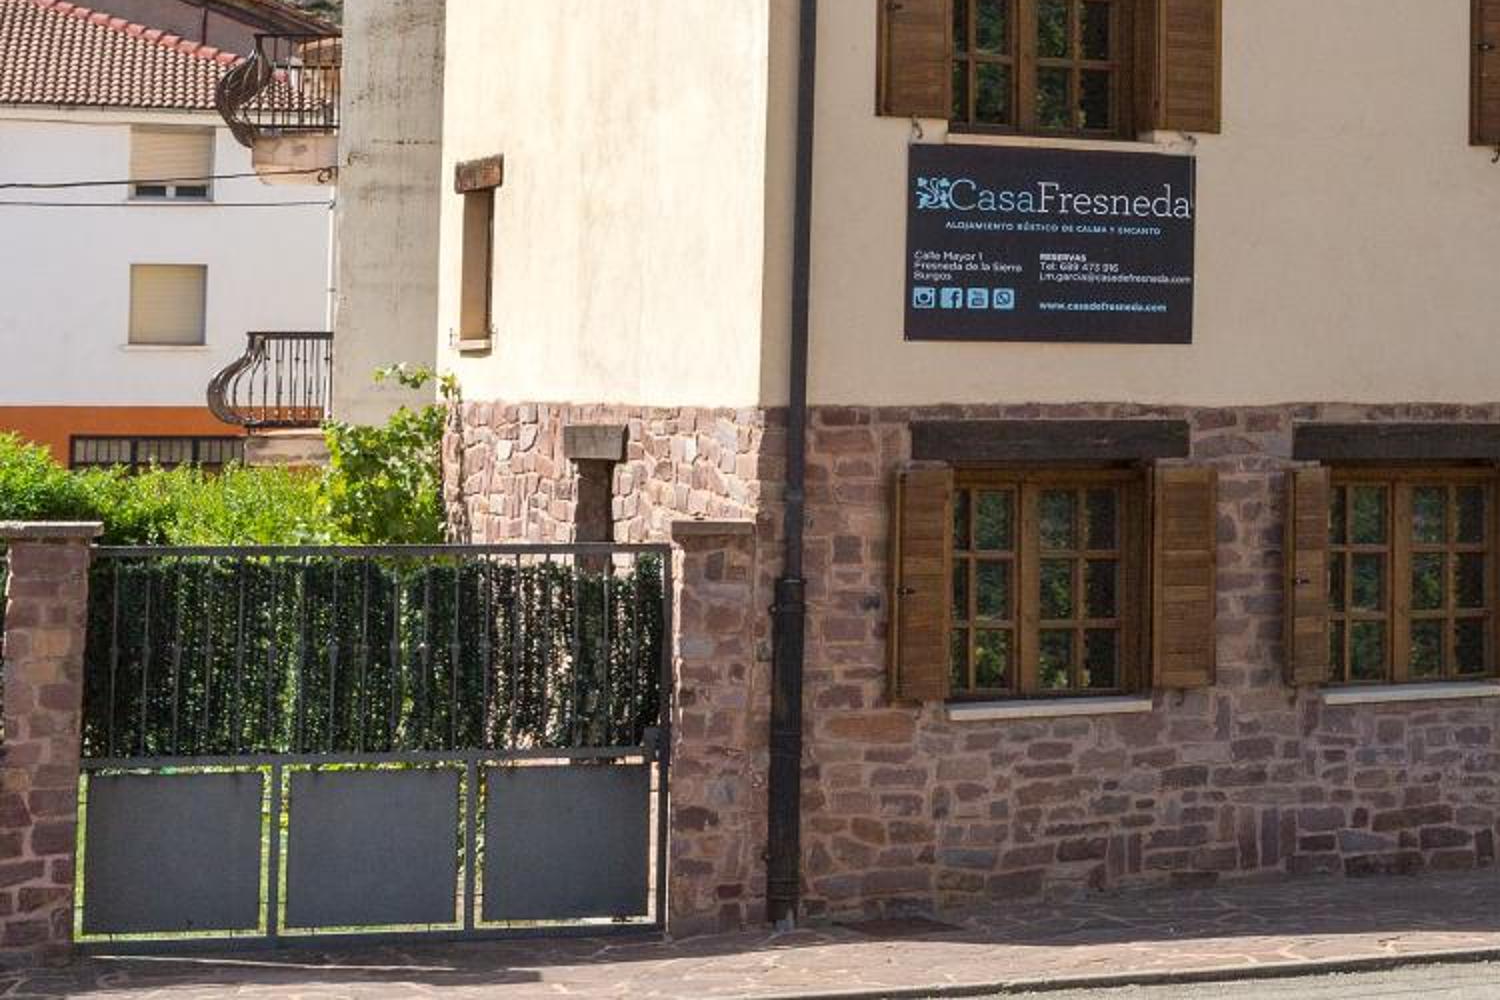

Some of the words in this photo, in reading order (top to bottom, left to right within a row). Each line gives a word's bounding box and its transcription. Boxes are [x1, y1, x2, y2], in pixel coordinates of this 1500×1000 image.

[1076, 225, 1107, 233] CALMA
[1118, 227, 1161, 235] ENCANTO
[914, 251, 941, 260] Calle
[943, 251, 976, 262] Mayor
[1039, 253, 1087, 262] RESERVAS
[914, 261, 962, 271] Fresneda
[965, 262, 978, 271] de
[981, 262, 990, 271] la
[992, 262, 1023, 273] Sierra
[914, 272, 952, 282] Burgos
